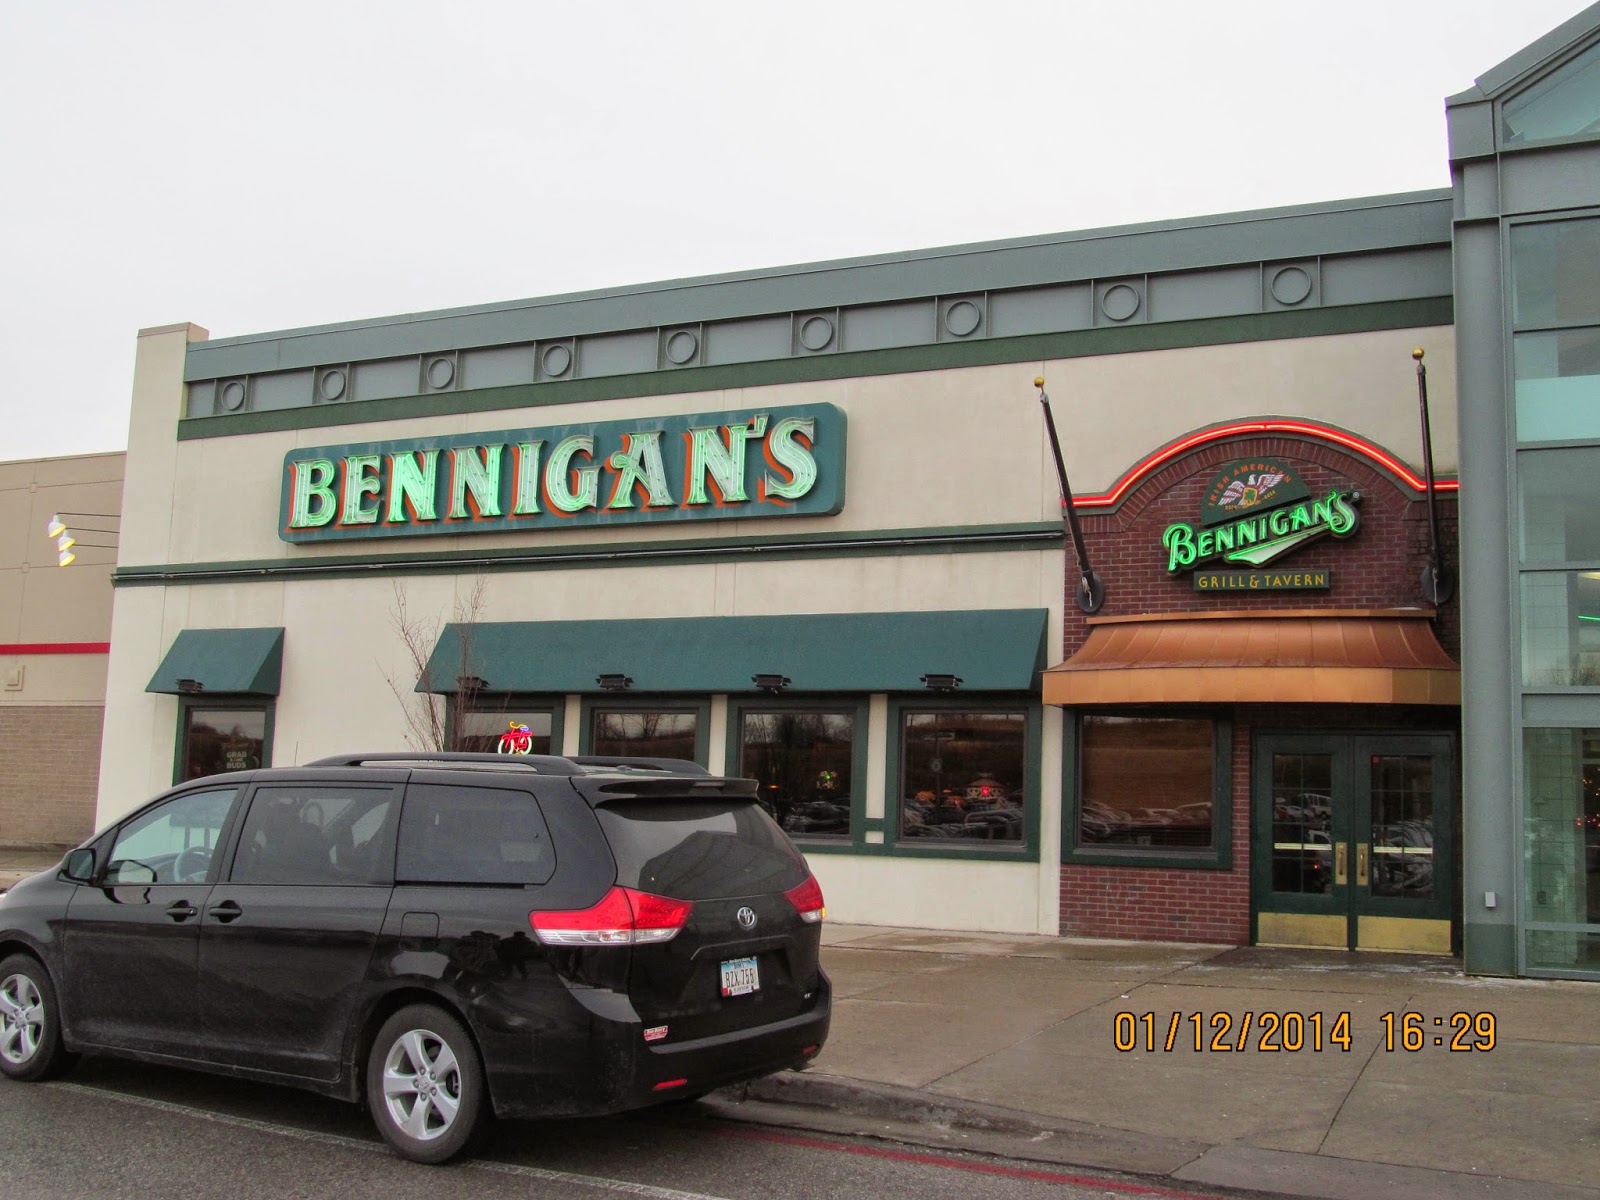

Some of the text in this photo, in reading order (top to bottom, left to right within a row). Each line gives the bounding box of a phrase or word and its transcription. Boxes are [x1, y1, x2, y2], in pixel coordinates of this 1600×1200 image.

[288, 413, 818, 529] BENNIGAN'S
[1207, 463, 1292, 507] IRISH AMERICAN
[1198, 574, 1325, 589] GRILL & TAVERN
